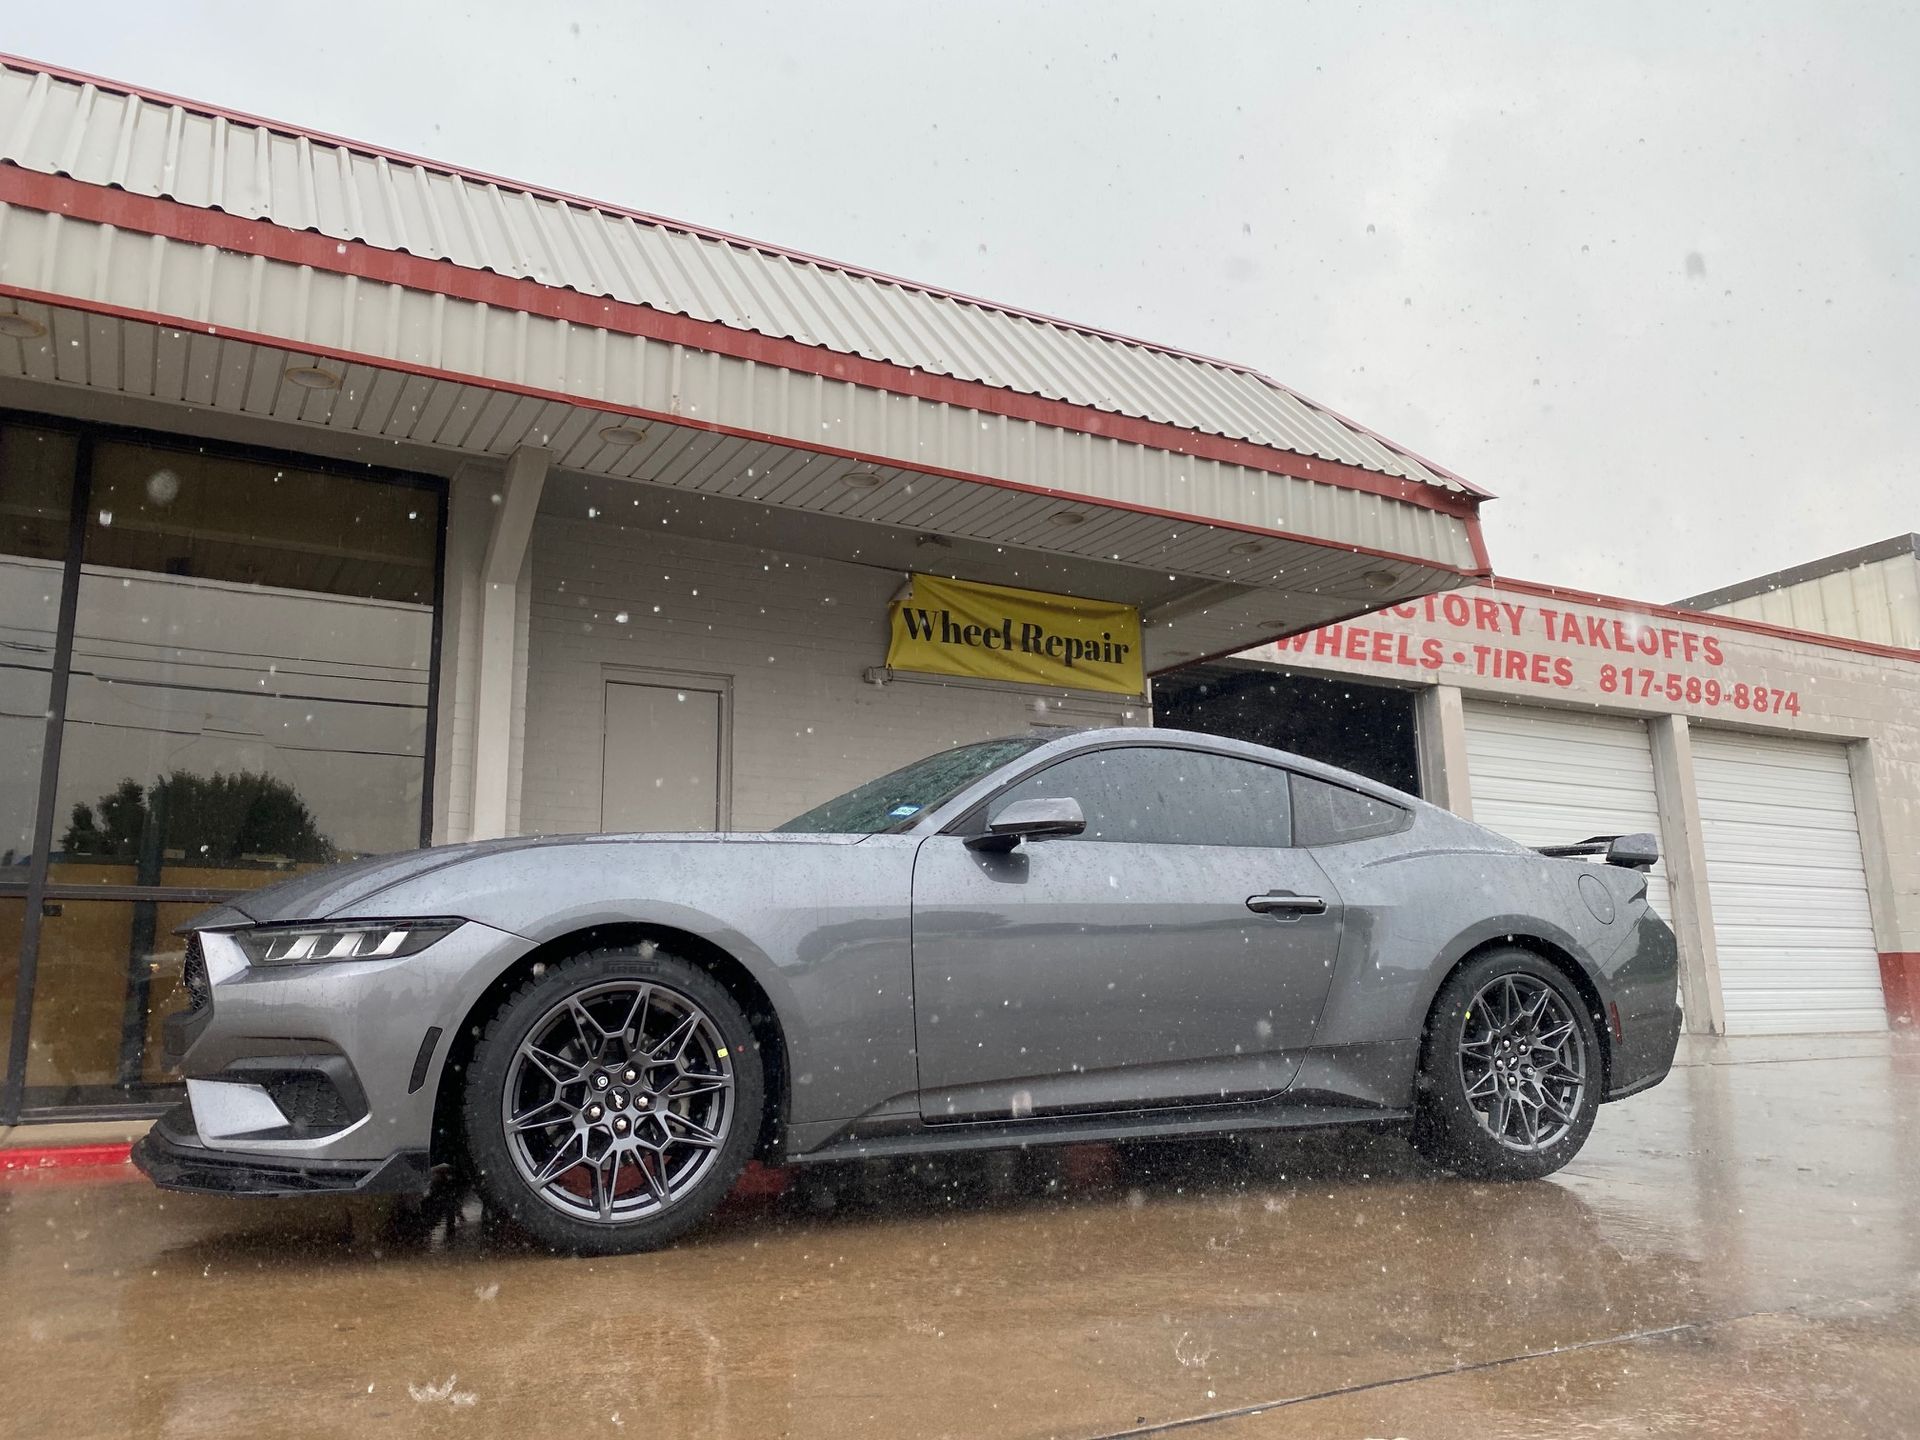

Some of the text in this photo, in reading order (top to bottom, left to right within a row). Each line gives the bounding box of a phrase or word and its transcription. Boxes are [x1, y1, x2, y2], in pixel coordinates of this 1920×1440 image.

[902, 607, 1130, 667] Wheel Repair
[1540, 608, 1724, 666] TAKEOFFS
[1473, 645, 1574, 687] TIRES
[1600, 664, 1801, 717] 817-589-8874
